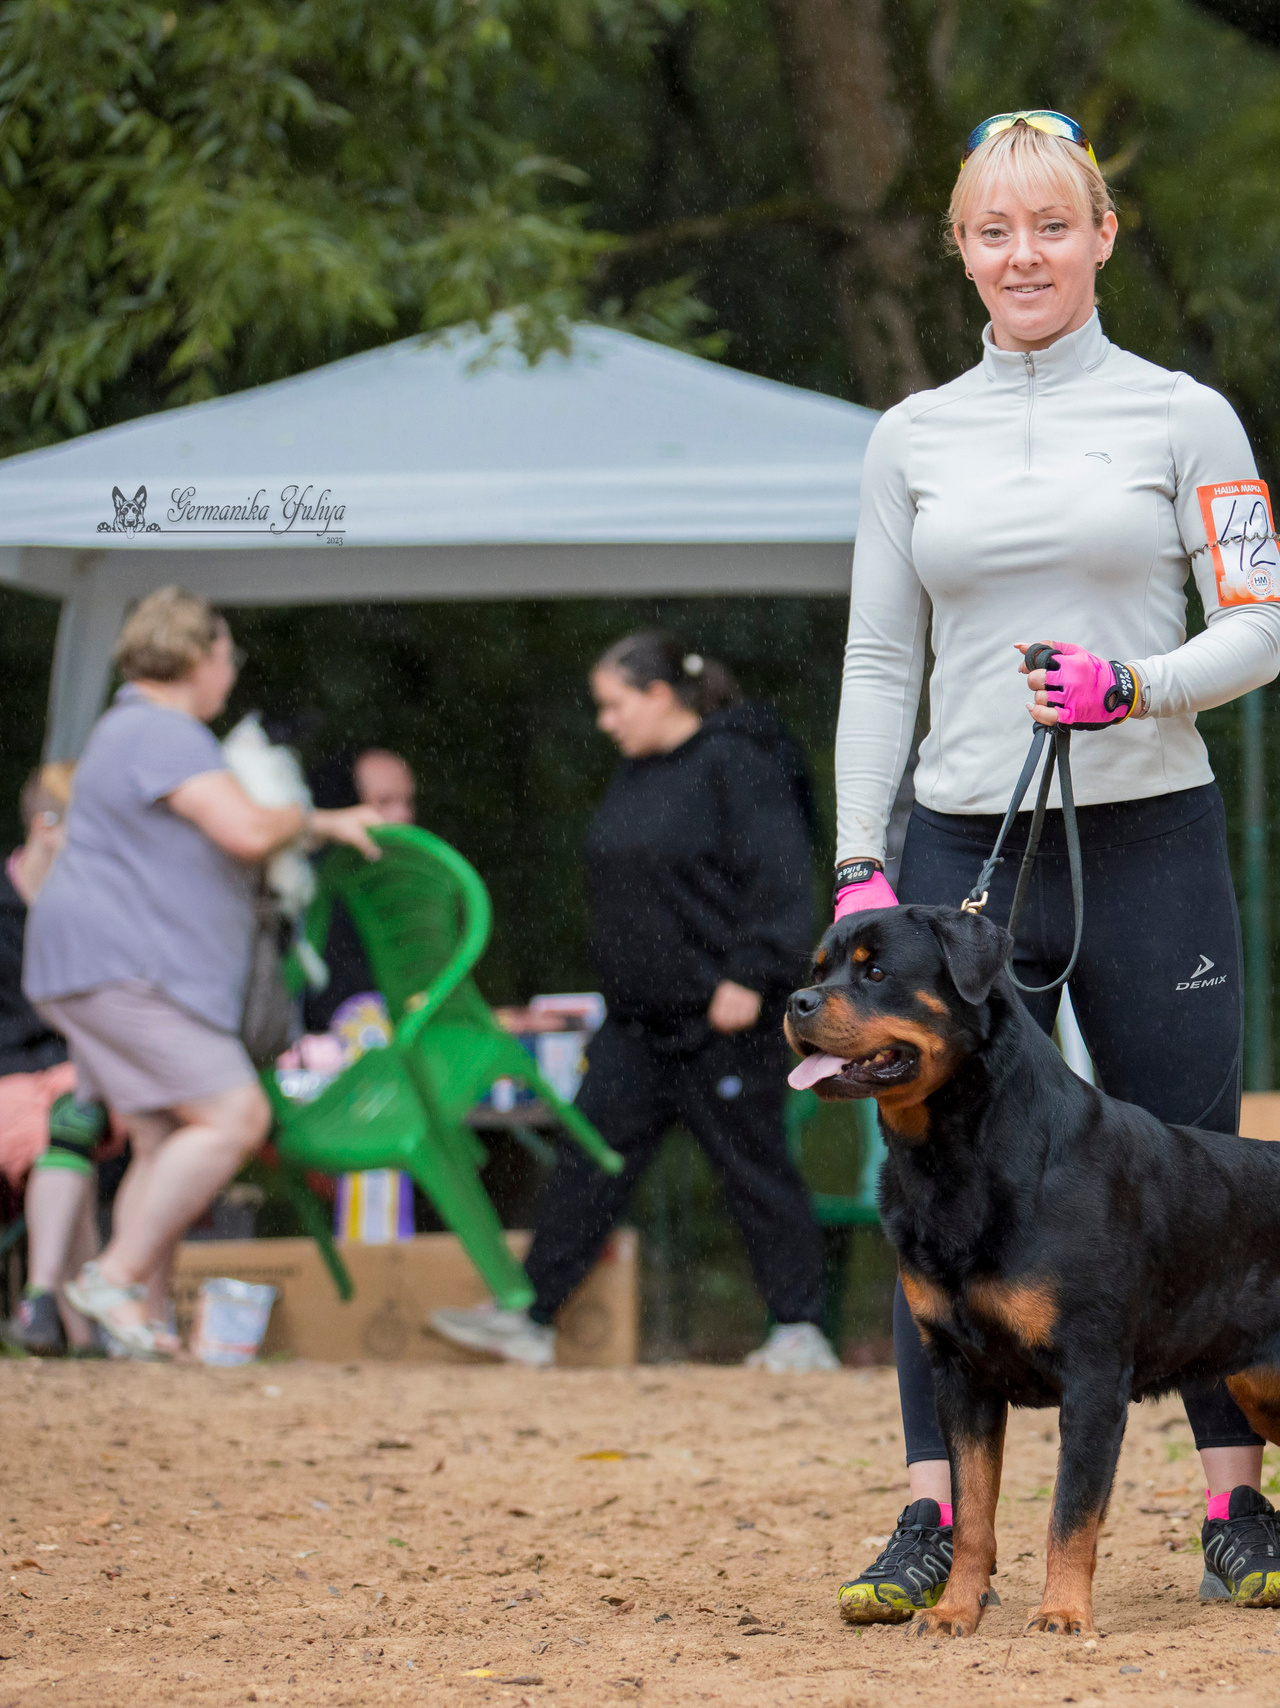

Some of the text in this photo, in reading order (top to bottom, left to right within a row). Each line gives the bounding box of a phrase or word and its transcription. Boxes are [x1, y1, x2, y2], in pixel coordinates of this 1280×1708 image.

[1214, 484, 1262, 495] НАША МАРКА
[1219, 499, 1277, 572] 42
[1175, 974, 1228, 991] DEMIX
